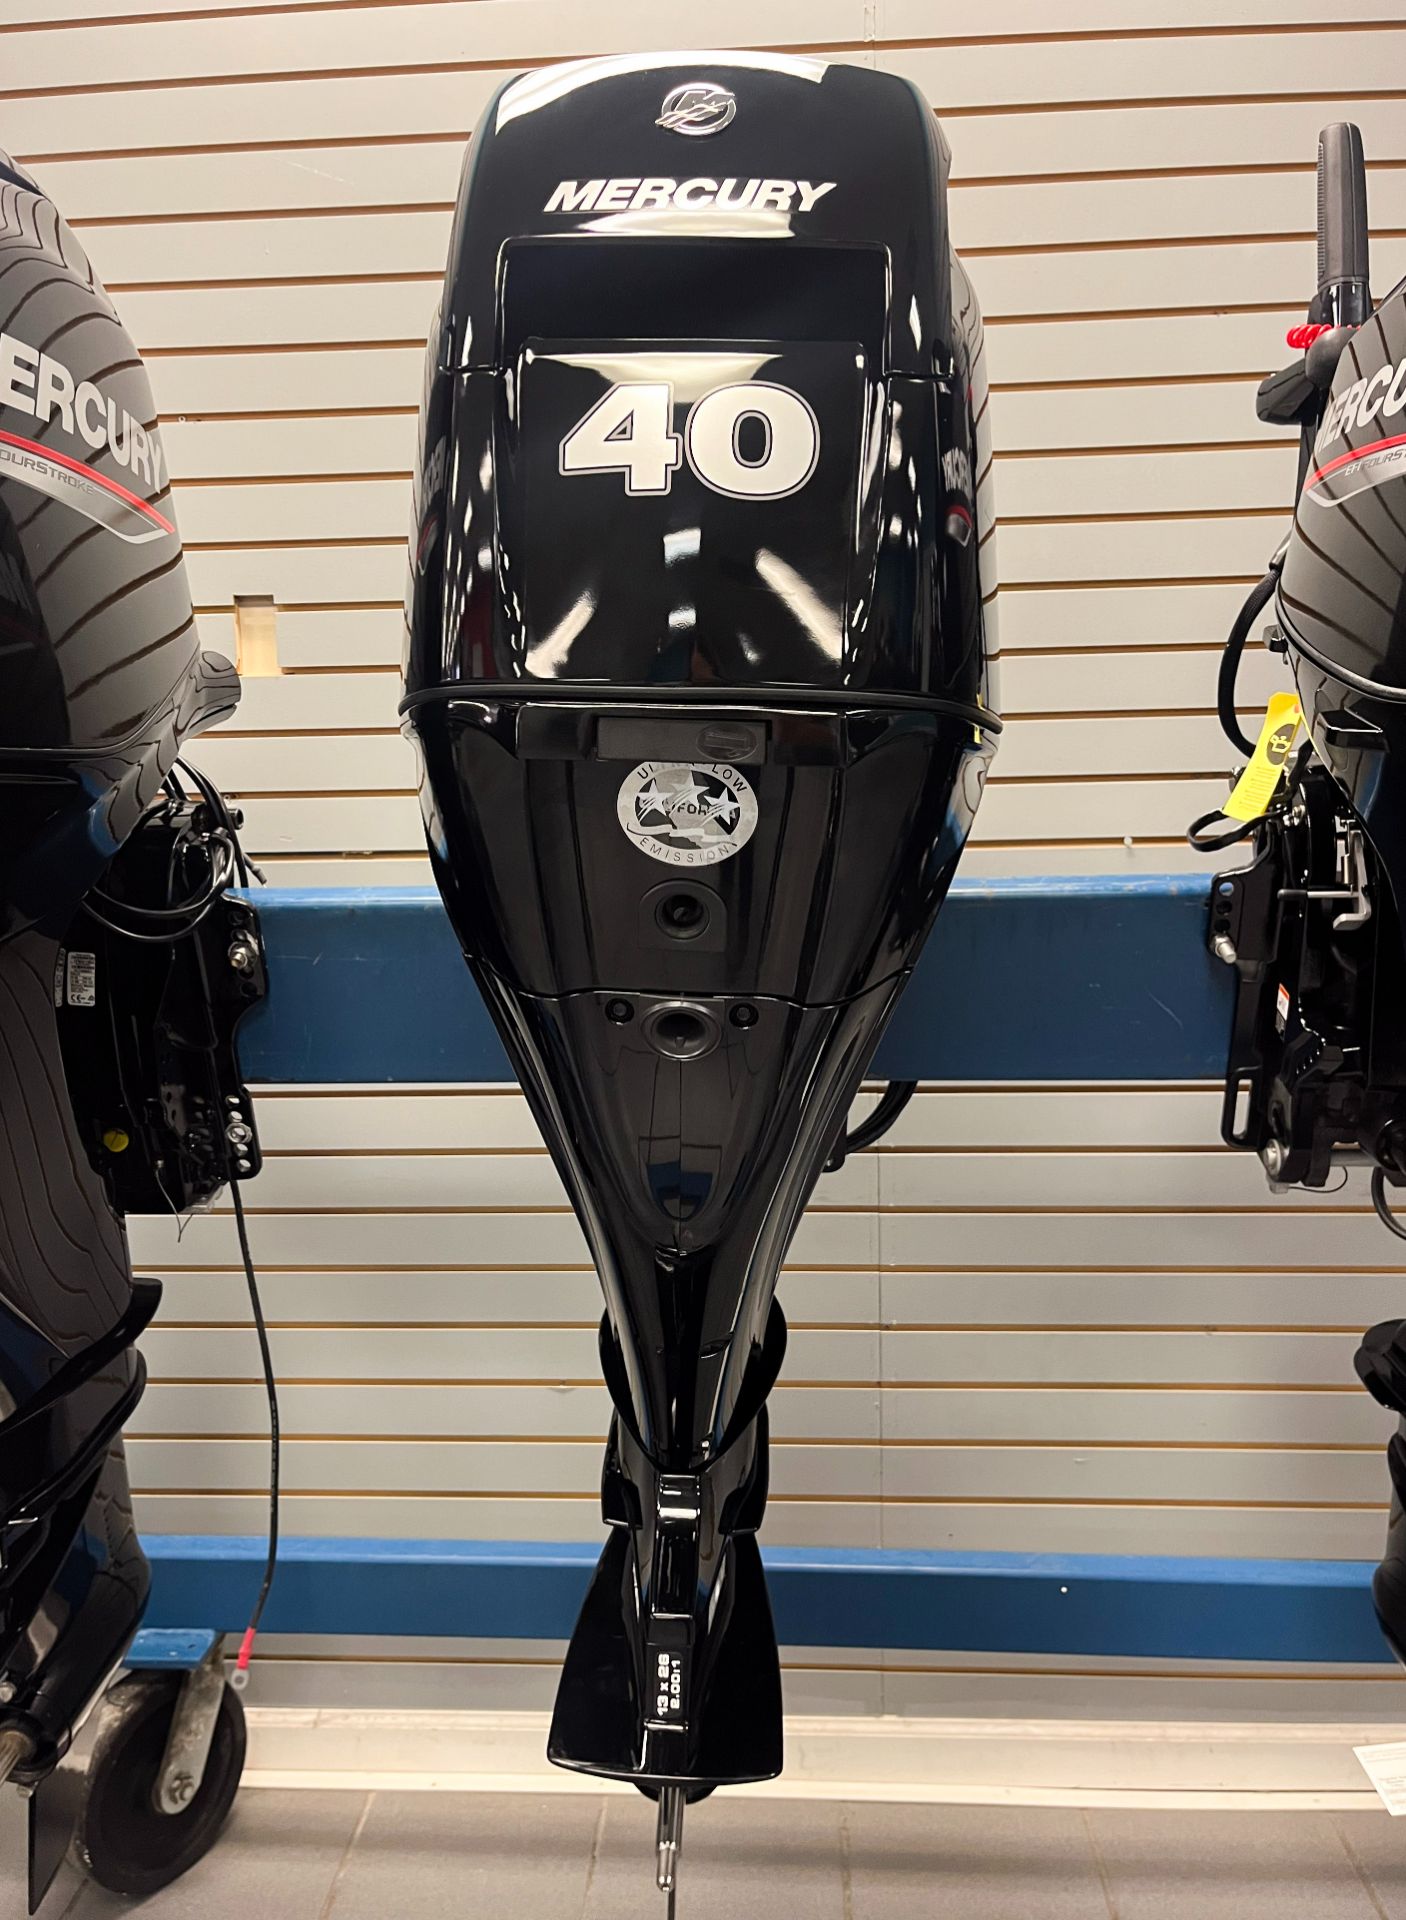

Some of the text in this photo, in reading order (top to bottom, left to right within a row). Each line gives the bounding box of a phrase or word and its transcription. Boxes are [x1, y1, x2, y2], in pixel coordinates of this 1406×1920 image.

[543, 178, 838, 213] MERCURY
[559, 380, 821, 501] 40
[712, 764, 747, 792] LOW
[639, 837, 729, 863] EMISSION
[657, 1695, 669, 1716] 13
